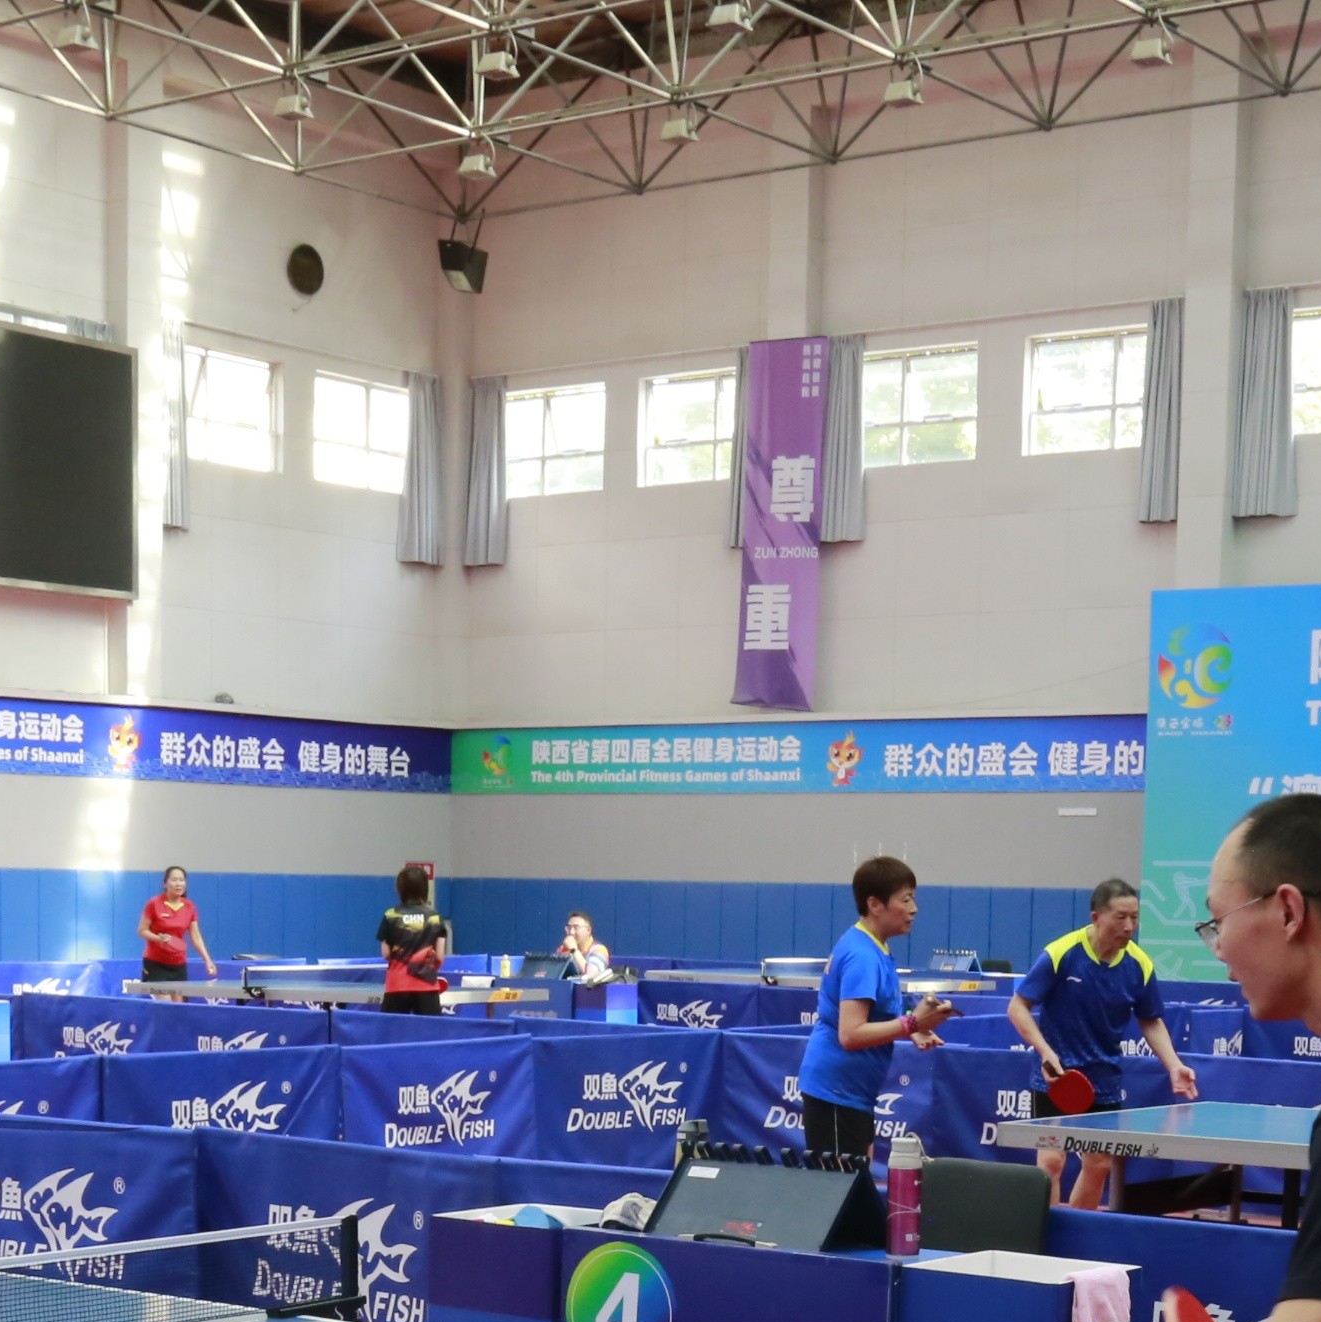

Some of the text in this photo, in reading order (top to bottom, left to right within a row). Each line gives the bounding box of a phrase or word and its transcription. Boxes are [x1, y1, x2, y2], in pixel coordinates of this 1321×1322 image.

[770, 456, 816, 522] 尊
[779, 546, 819, 559] ZHONG
[743, 584, 792, 650] 重
[14, 746, 31, 763] of
[31, 747, 85, 765] Shaanxi
[160, 731, 411, 778] 群众的盛会 健身的舞台
[531, 735, 801, 765] 陕西省第四届全民健身运动会
[884, 741, 1145, 778] 群众的盛会 健身的
[531, 768, 801, 783] The 4th Provincial Fitness Games of Shaanxi
[384, 1118, 495, 1149] DOUBLE FISH
[566, 1107, 687, 1133] DOUBLE FISH
[873, 1119, 907, 1138] ISH
[1064, 1137, 1112, 1155] DOUBLE
[1113, 1143, 1142, 1157] FISH
